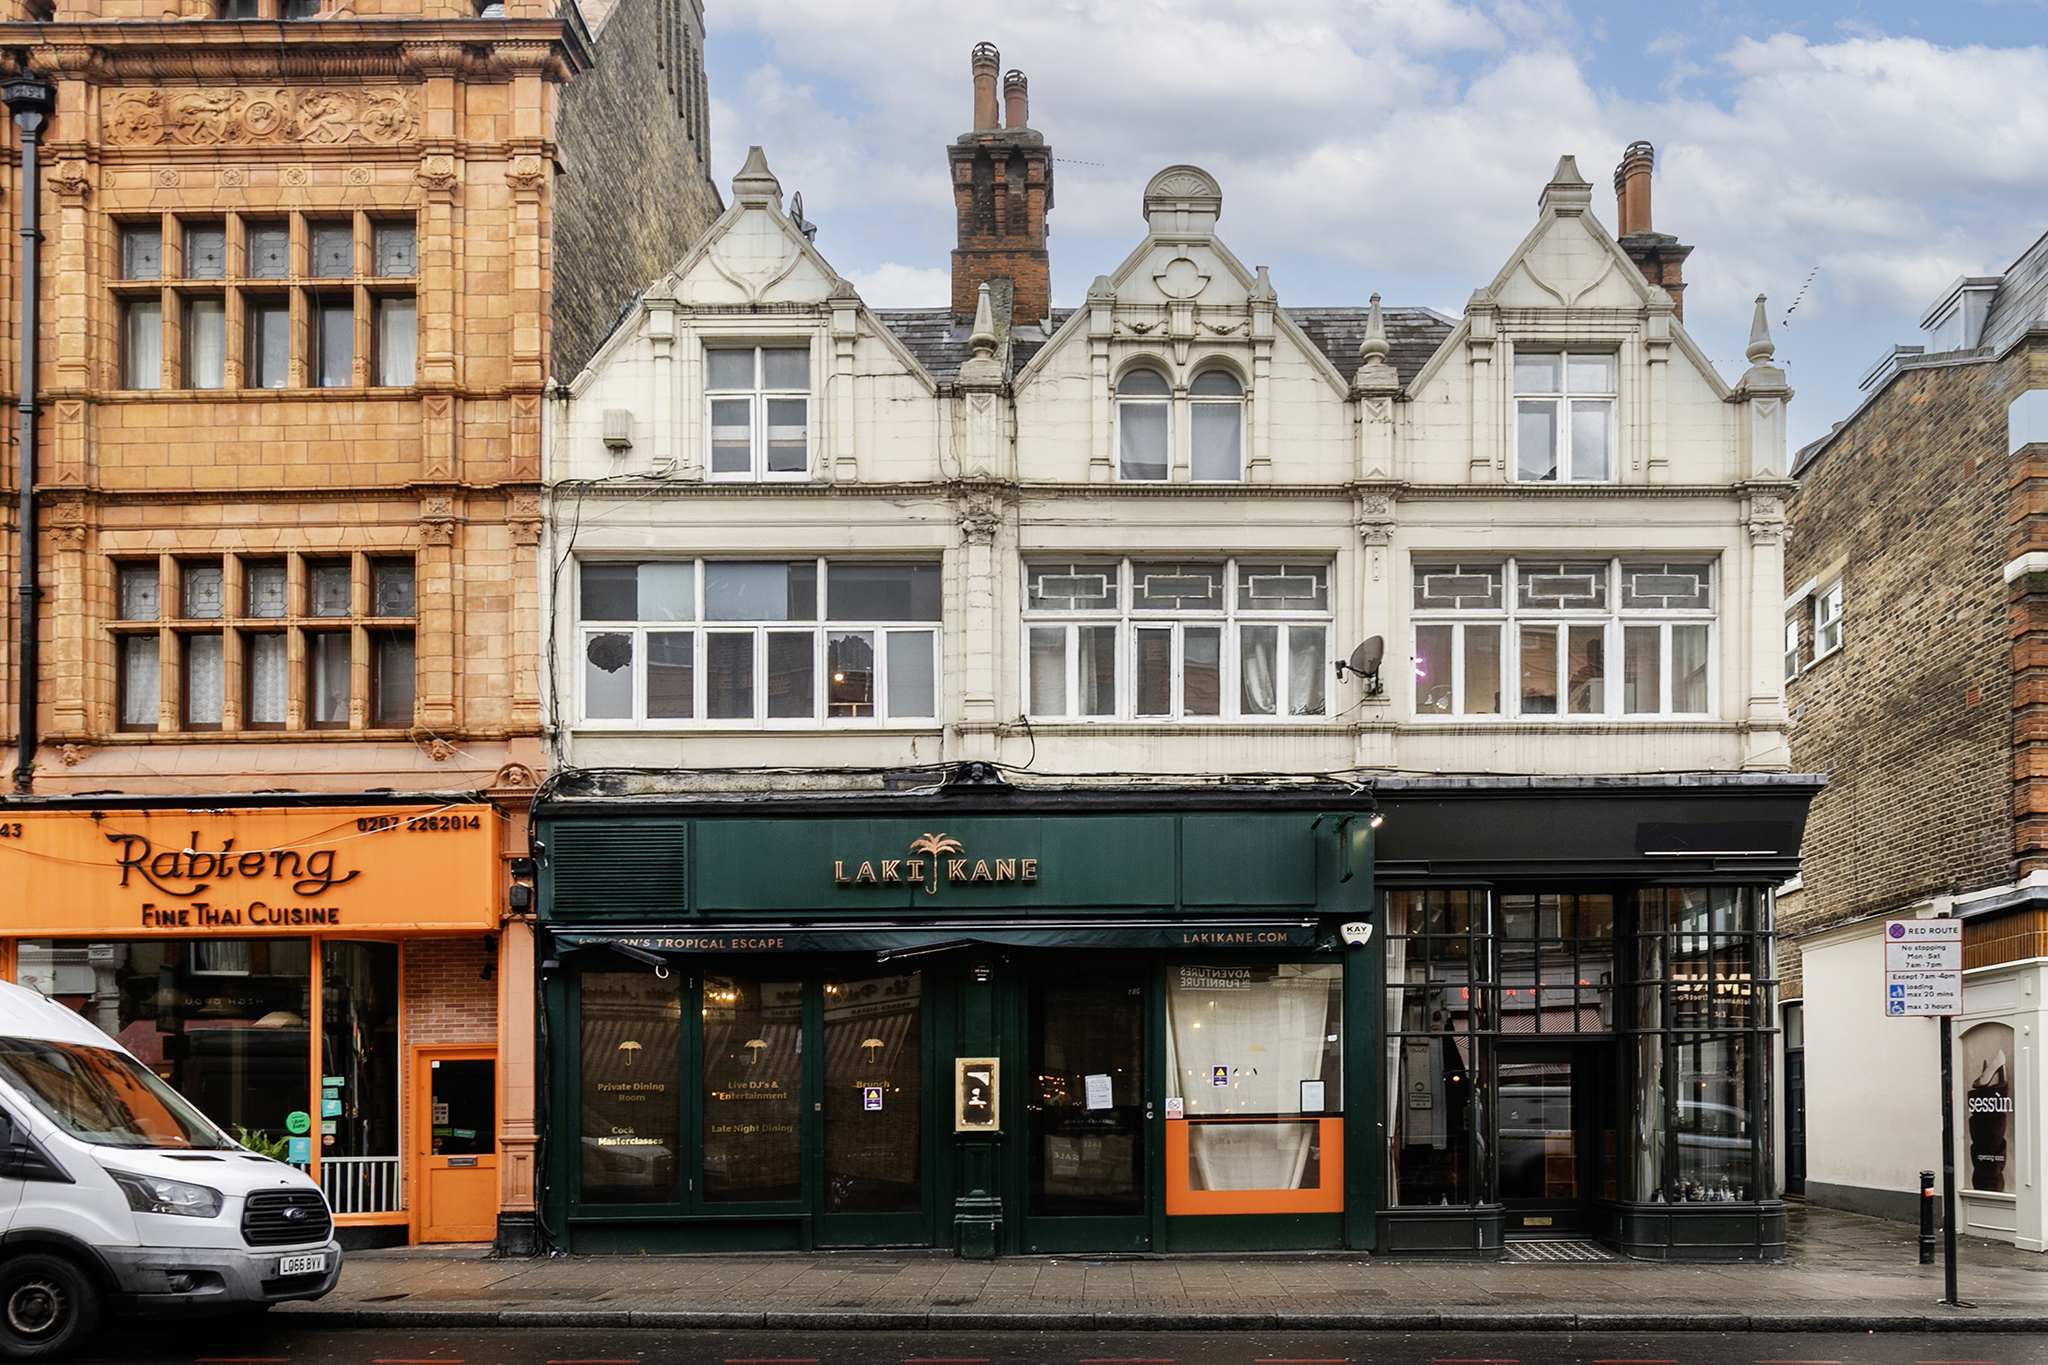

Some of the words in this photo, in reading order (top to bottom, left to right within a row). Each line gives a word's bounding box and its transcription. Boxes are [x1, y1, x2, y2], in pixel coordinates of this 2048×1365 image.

[357, 817, 399, 831] 0207
[407, 816, 480, 831] 2262014
[105, 831, 361, 897] Rabieng
[834, 859, 924, 883] LAKI
[947, 858, 1038, 882] KANE
[1908, 927, 1926, 935] RED
[1183, 932, 1288, 943] LAKIKANE.COM
[656, 938, 726, 949] TROPICAL
[732, 938, 784, 949] ESCAPE
[597, 1083, 632, 1091] Private
[633, 1082, 665, 1092] Dining
[727, 1081, 748, 1089] Live
[771, 1081, 779, 1089] &
[618, 1094, 646, 1102] Room
[719, 1092, 787, 1100] Entertainment
[1968, 1092, 2013, 1112] sessùn
[611, 1126, 635, 1134] Cock
[711, 1125, 732, 1133] Late
[733, 1124, 760, 1134] Night
[762, 1124, 793, 1134] Dining
[597, 1137, 664, 1146] Masterclasses
